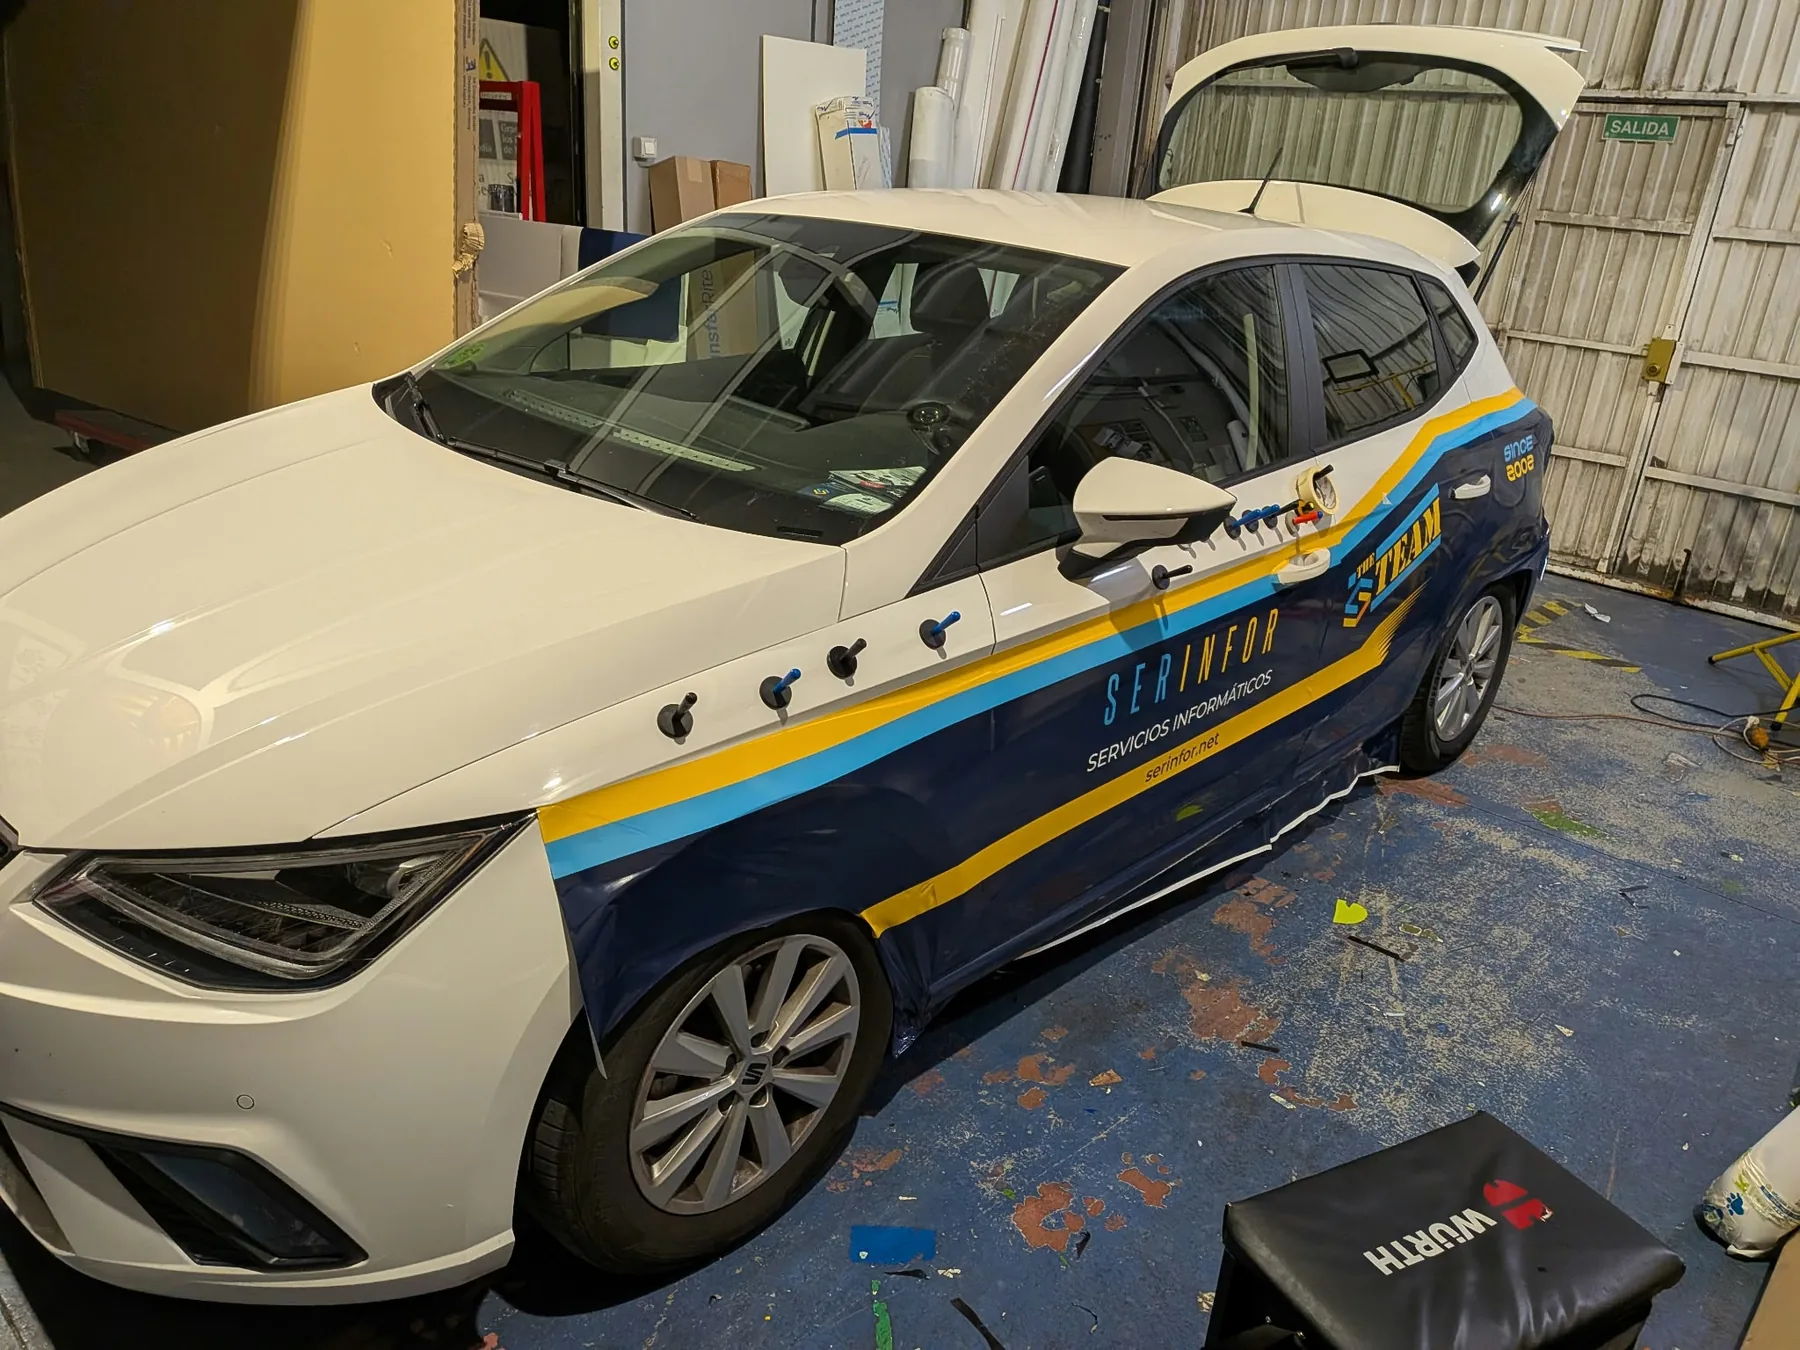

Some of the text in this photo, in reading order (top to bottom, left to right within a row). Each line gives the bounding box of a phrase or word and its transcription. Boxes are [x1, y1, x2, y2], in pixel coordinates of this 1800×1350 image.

[1610, 120, 1669, 135] SALIDA
[1504, 434, 1534, 462] SINCE
[1356, 552, 1375, 579] THE
[1375, 497, 1442, 596] TEAM
[1103, 608, 1279, 726] SERINFOR
[1086, 669, 1273, 772] SERVICIOS INFORMÁTICOS
[1145, 732, 1220, 783] serinfor.net
[1363, 1208, 1498, 1276] WÜRTH
